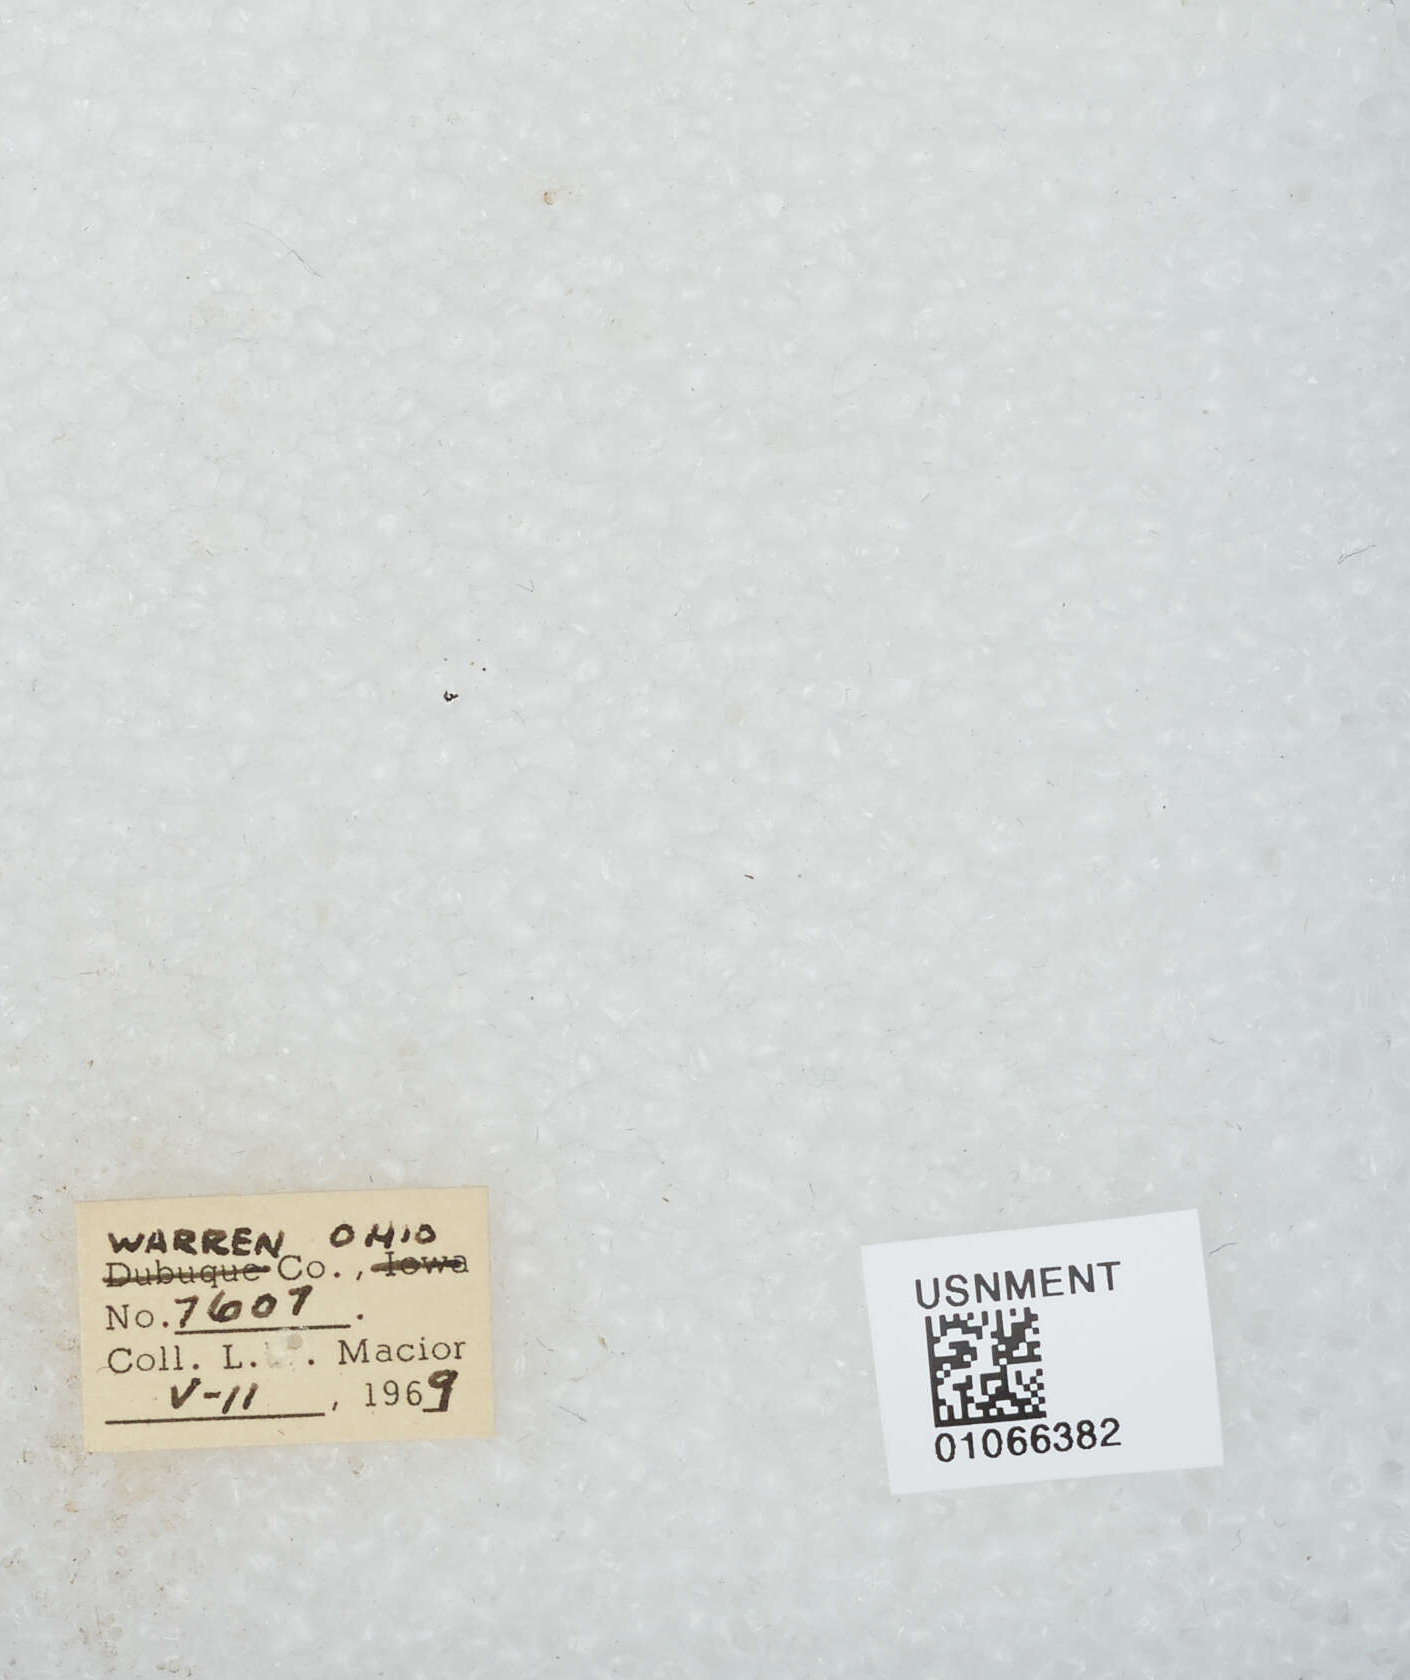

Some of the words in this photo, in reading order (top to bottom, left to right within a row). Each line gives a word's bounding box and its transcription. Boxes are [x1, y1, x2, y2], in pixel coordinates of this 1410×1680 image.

[107, 1226, 285, 1258] WARREN
[329, 1221, 437, 1249] OHIO
[104, 1259, 268, 1288] Dubuque
[383, 1250, 469, 1277] Iowa
[915, 1261, 1121, 1309] USNMENT
[107, 1344, 200, 1374] Coll.
[222, 1344, 258, 1370] L.
[338, 1337, 466, 1365] Macior
[365, 1369, 458, 1412] 1969
[934, 1417, 1122, 1462] 01066382
